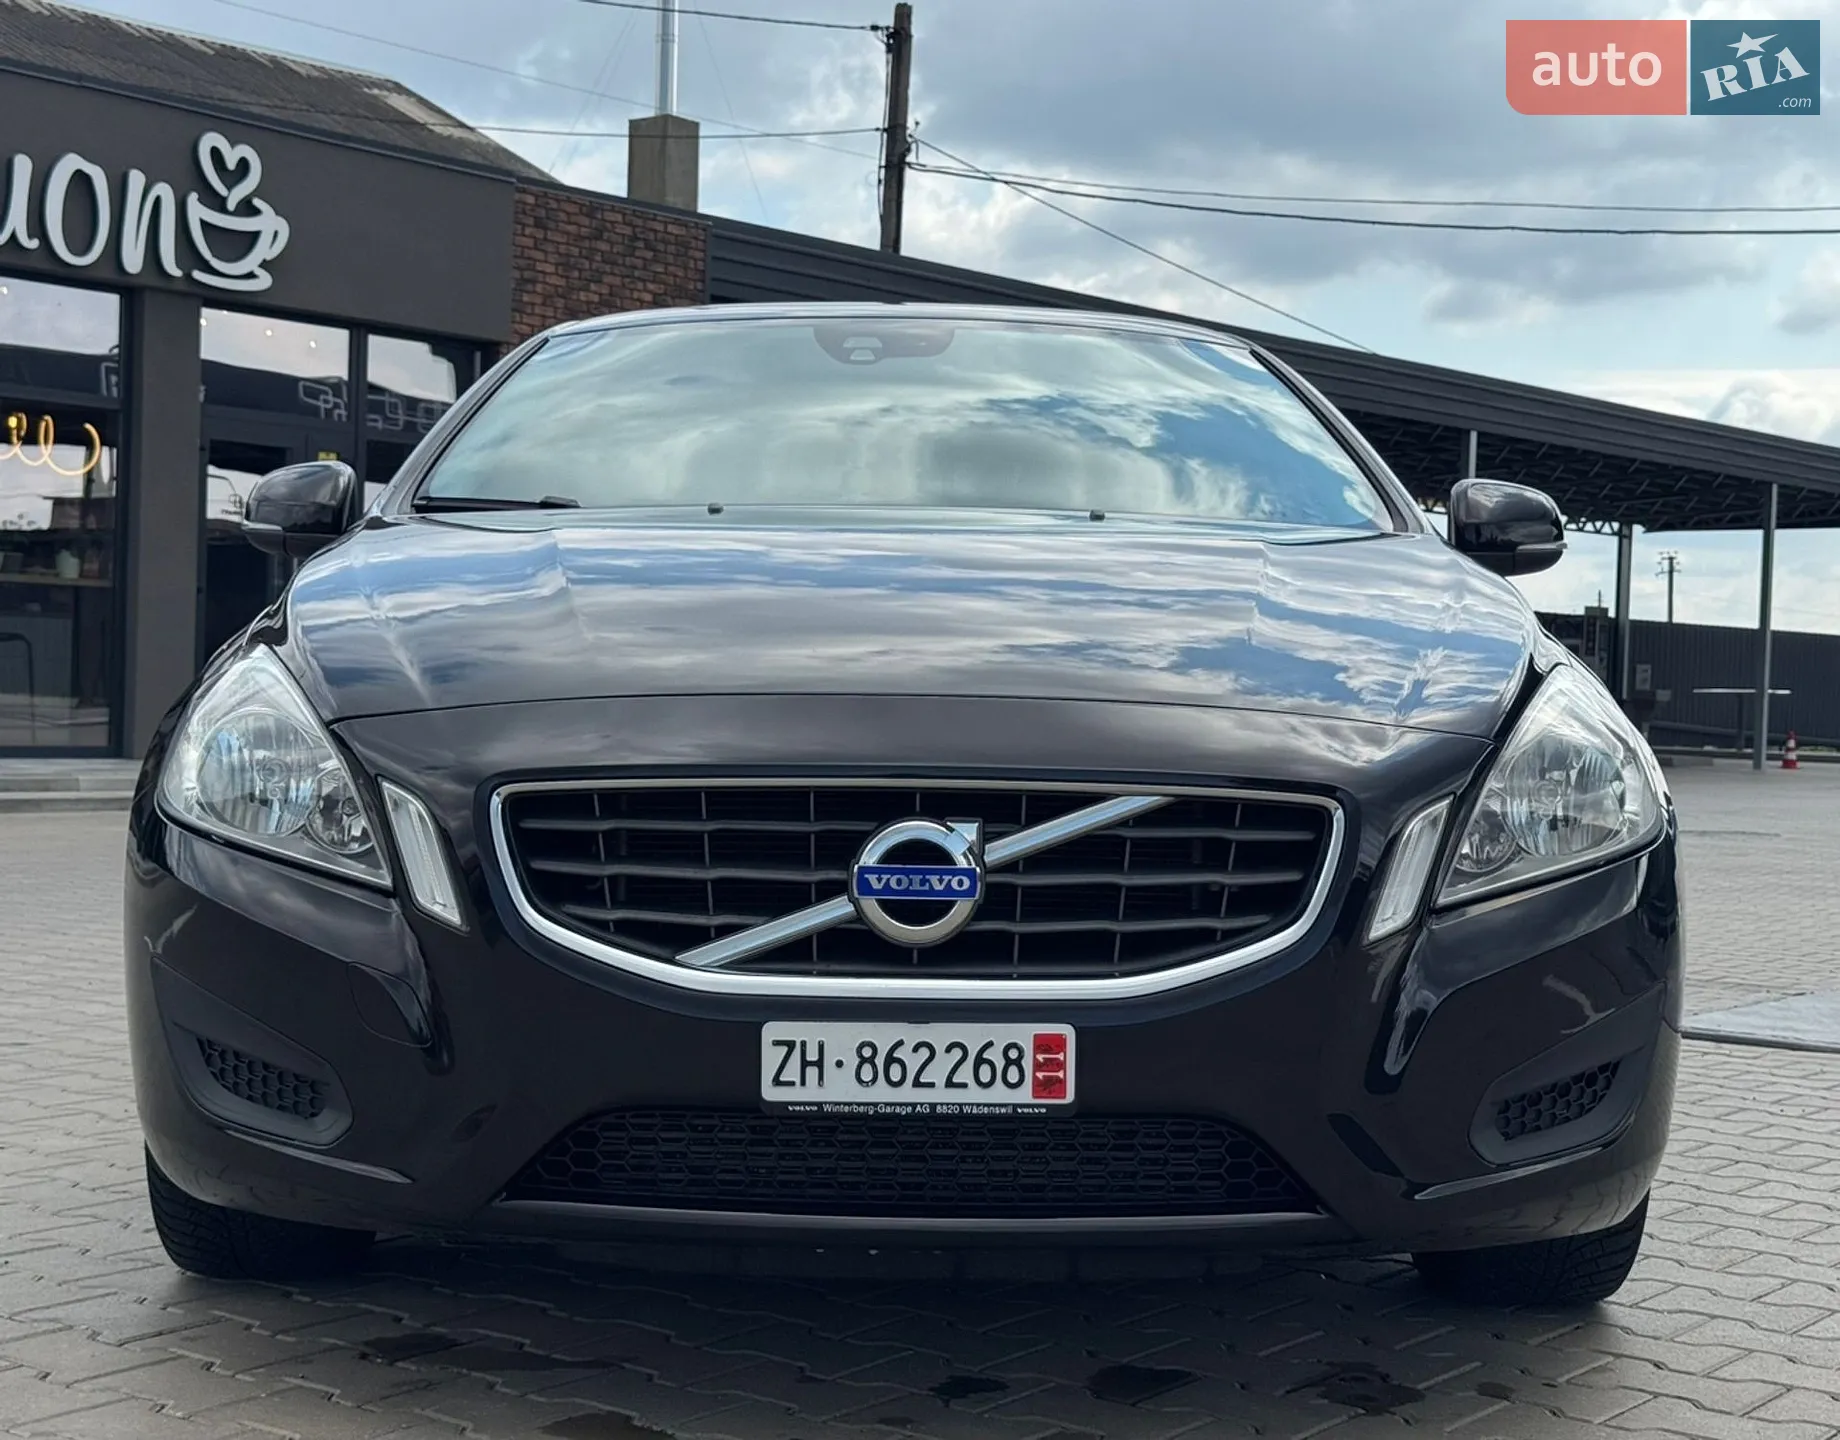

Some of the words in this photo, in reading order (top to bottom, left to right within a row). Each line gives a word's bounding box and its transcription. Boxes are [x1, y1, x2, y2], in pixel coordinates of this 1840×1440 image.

[864, 874, 971, 891] VOLVO
[822, 1103, 912, 1115] Winterberg-Garage
[914, 1104, 930, 1113] AG
[936, 1105, 960, 1114] 8820
